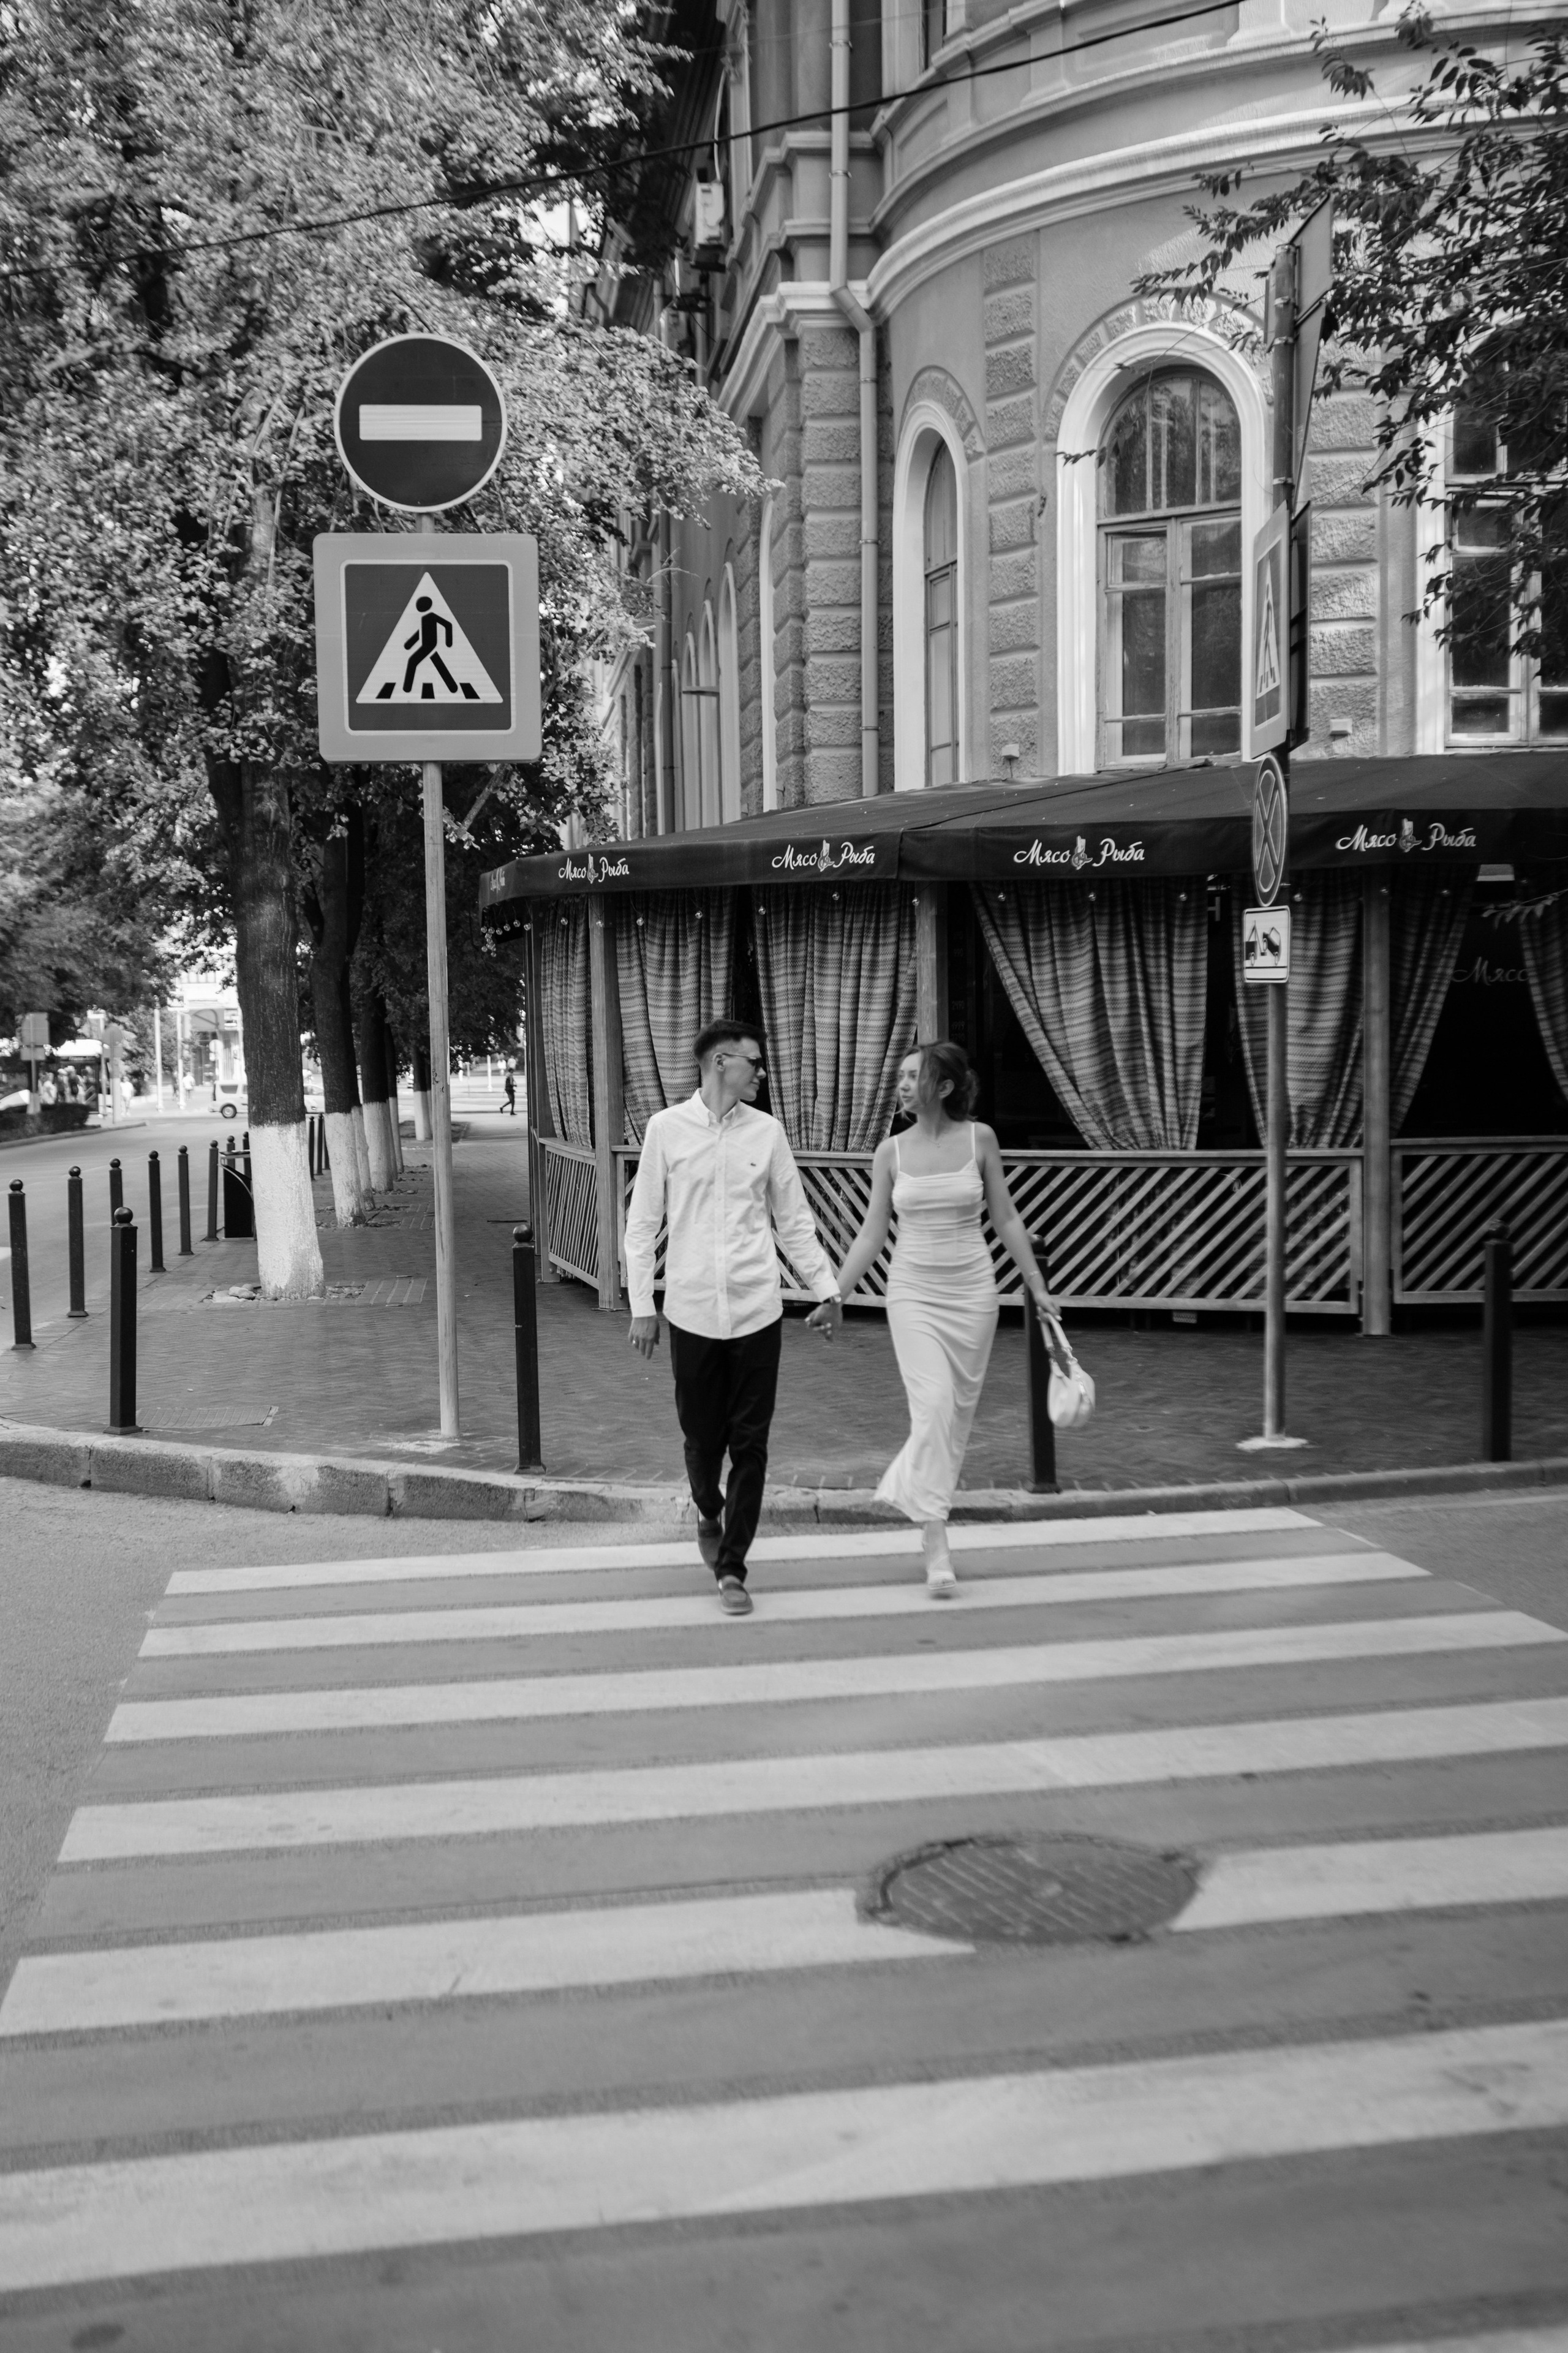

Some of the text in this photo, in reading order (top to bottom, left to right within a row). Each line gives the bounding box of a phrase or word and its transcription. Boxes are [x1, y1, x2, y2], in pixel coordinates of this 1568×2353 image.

[1335, 822, 1477, 852] Мясо Рыба
[772, 841, 875, 870] Мясо Рыба
[1013, 837, 1145, 867] Мясо Рыба
[558, 856, 630, 882] Мясо Рыба
